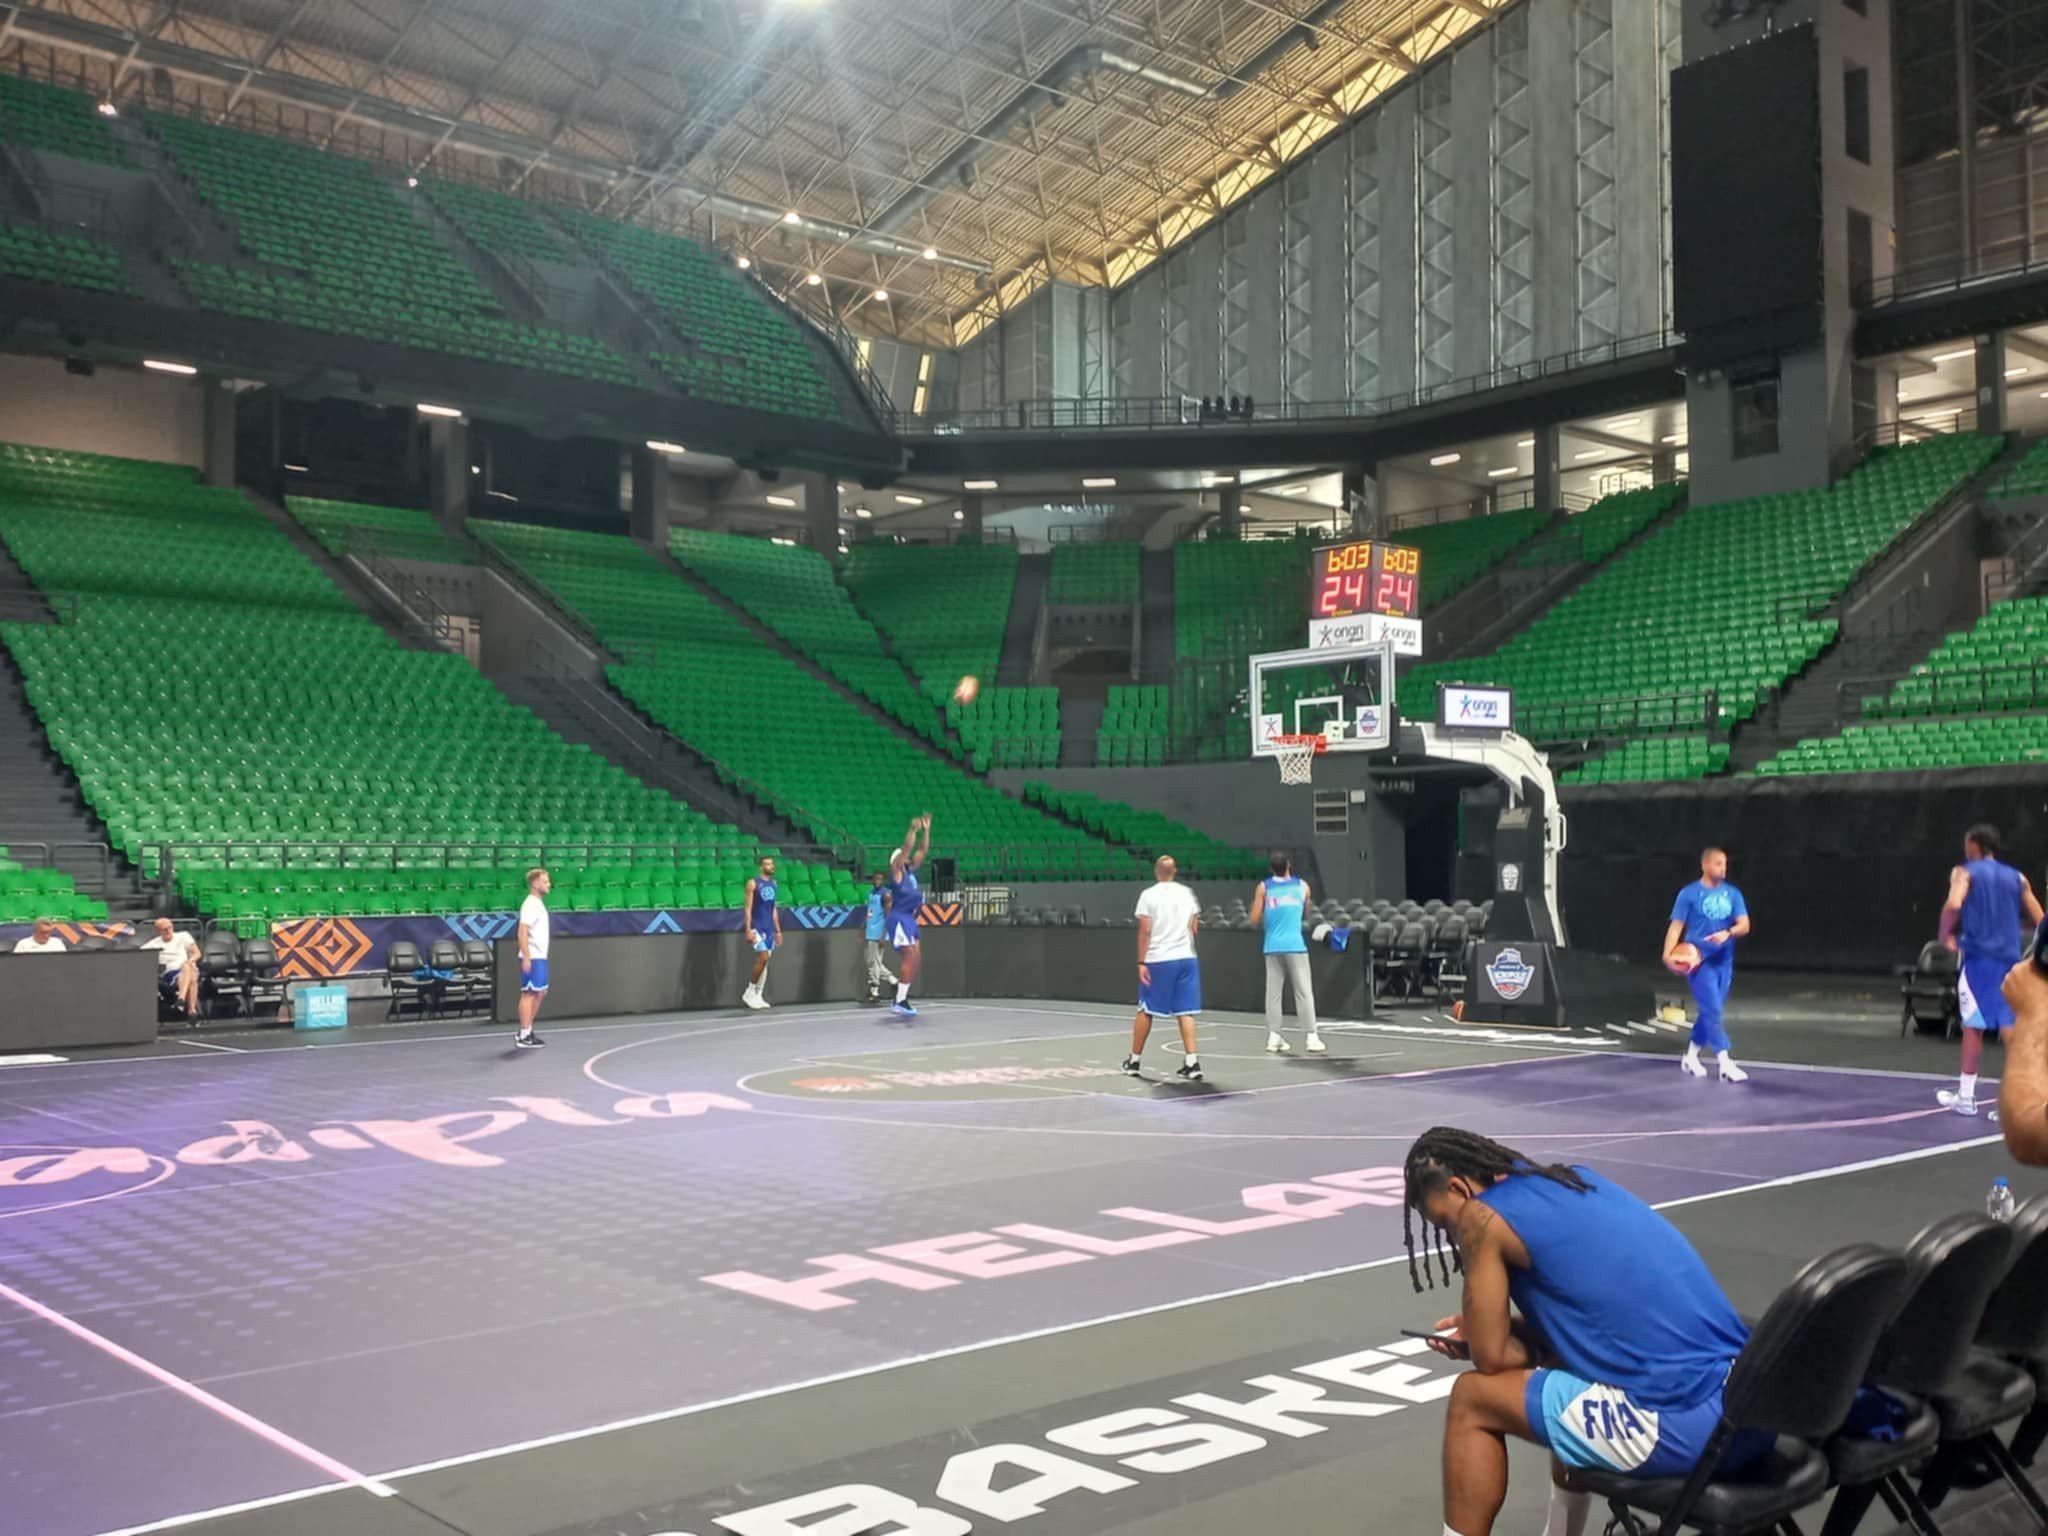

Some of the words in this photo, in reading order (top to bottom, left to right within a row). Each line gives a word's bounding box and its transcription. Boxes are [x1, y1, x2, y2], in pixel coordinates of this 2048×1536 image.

[1327, 543, 1370, 573] 6:03
[1383, 546, 1418, 575] 6:03
[1321, 574, 1364, 612] 24
[1377, 573, 1413, 612] 24
